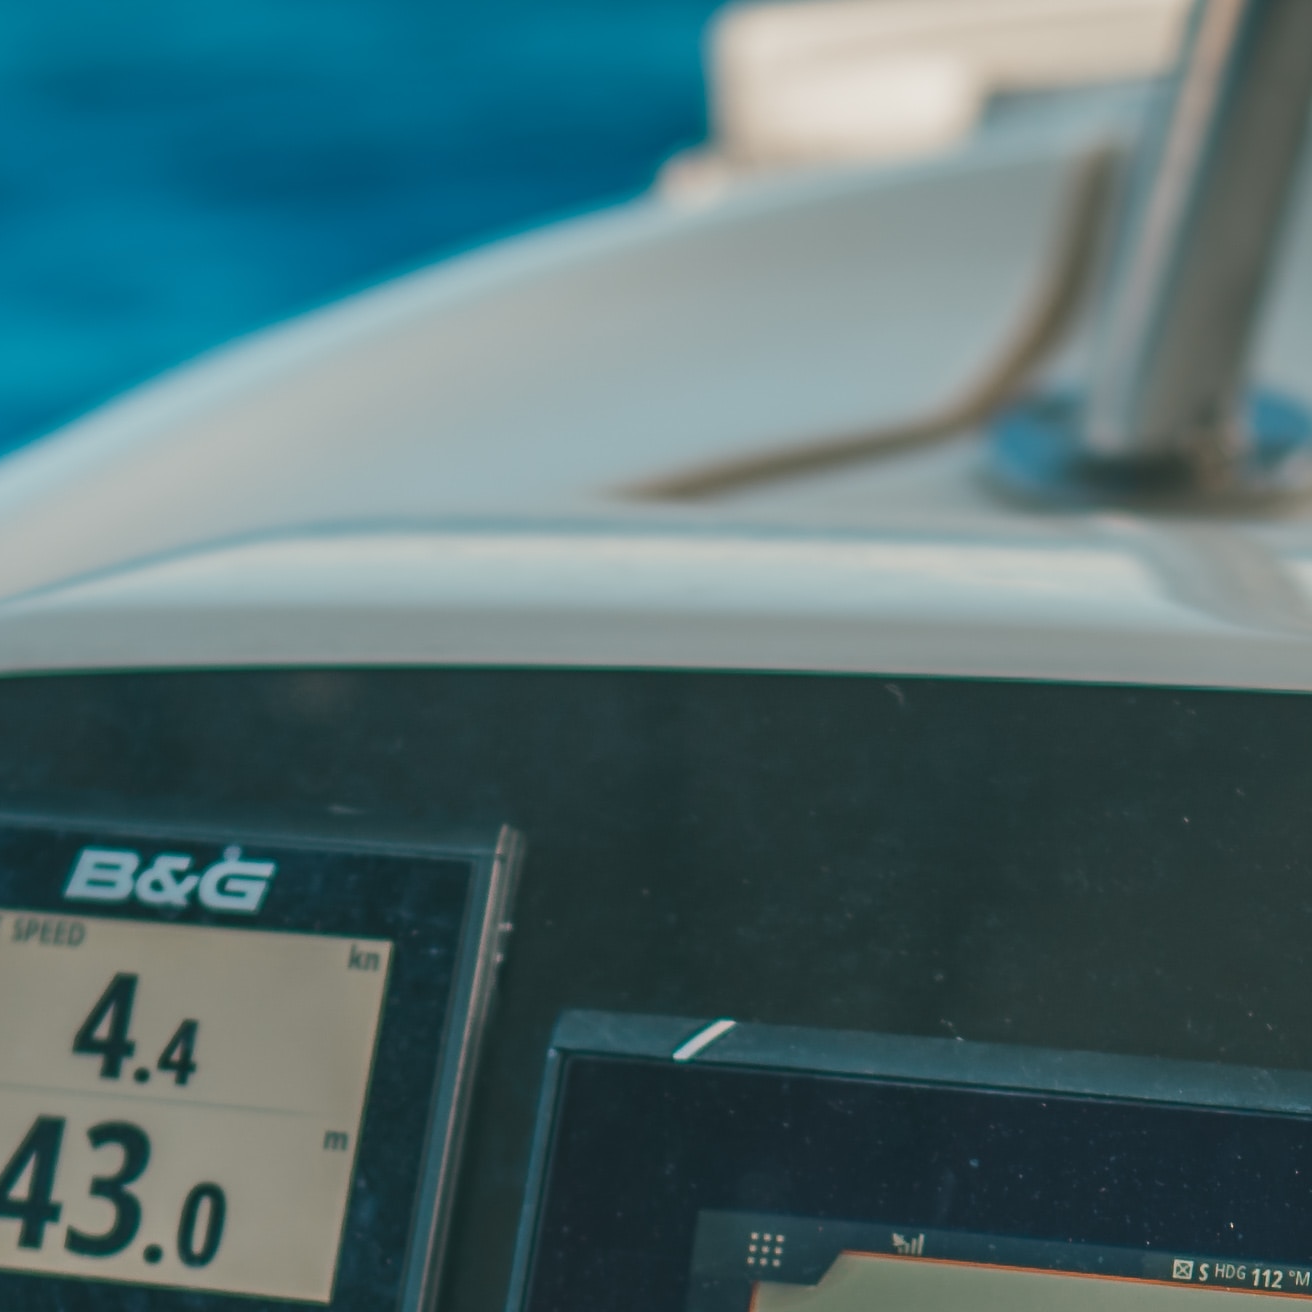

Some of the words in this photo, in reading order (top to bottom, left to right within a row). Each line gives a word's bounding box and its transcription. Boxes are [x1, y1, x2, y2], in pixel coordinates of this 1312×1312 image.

[64, 847, 276, 914] B&G
[12, 917, 86, 948] SPEED
[347, 946, 381, 972] kn
[71, 972, 200, 1087] 4.4
[323, 1130, 348, 1152] m
[1215, 1262, 1245, 1281] HDG
[1251, 1268, 1283, 1289] 112
